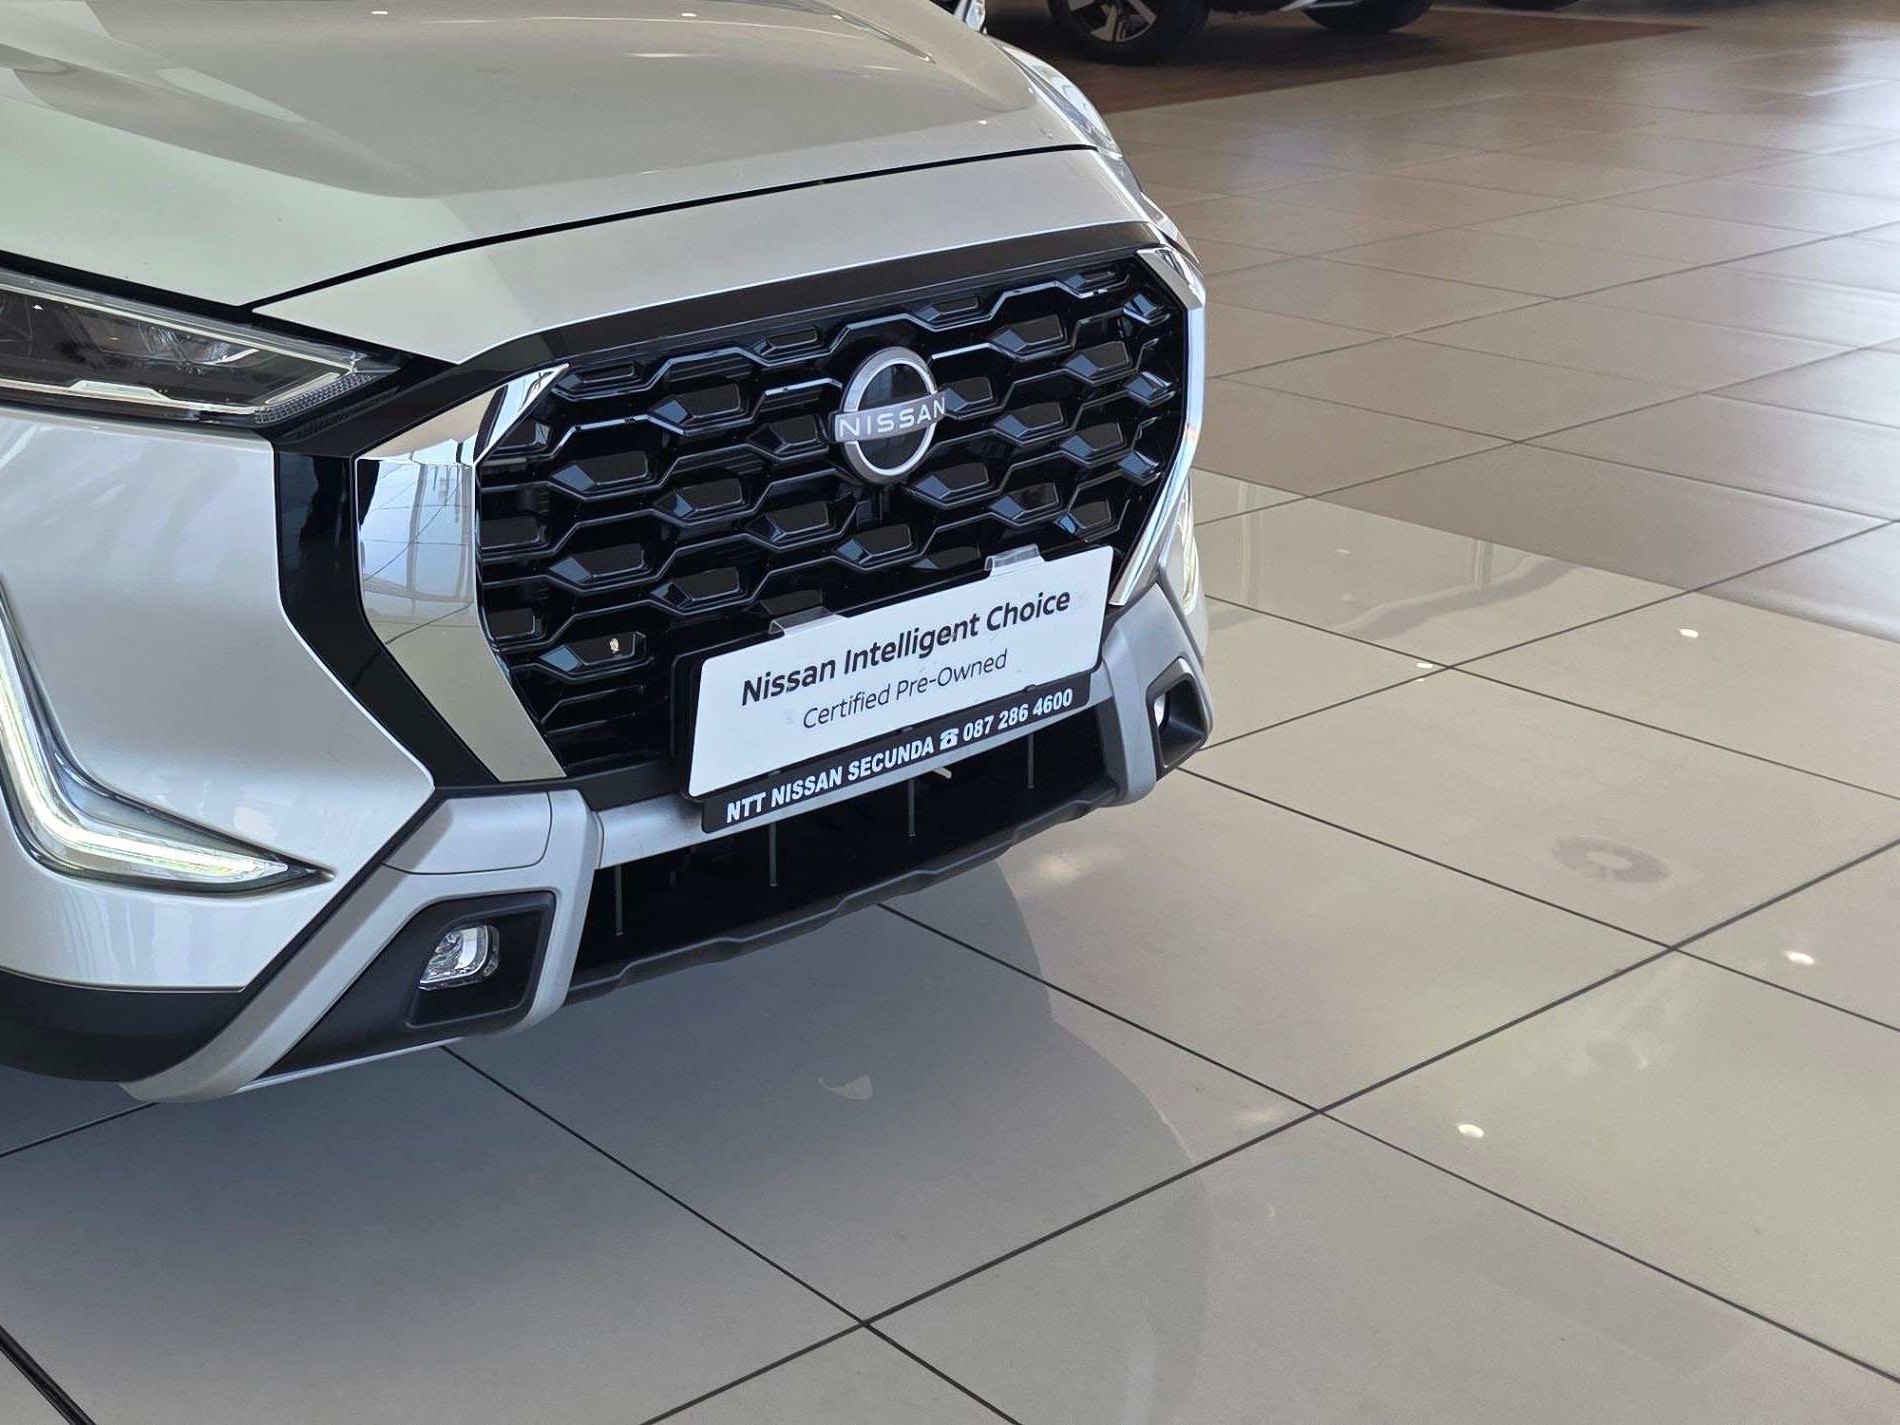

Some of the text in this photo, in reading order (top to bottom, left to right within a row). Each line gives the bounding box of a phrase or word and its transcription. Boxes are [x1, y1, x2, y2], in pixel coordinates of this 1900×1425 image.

[839, 396, 945, 438] NISSAN
[741, 589, 1071, 706] Nissan Intelligent Choice
[803, 649, 1008, 729] Certified Pre-Owned
[726, 688, 1073, 824] NTT NISSAN SECUNDA 087 286 4600
